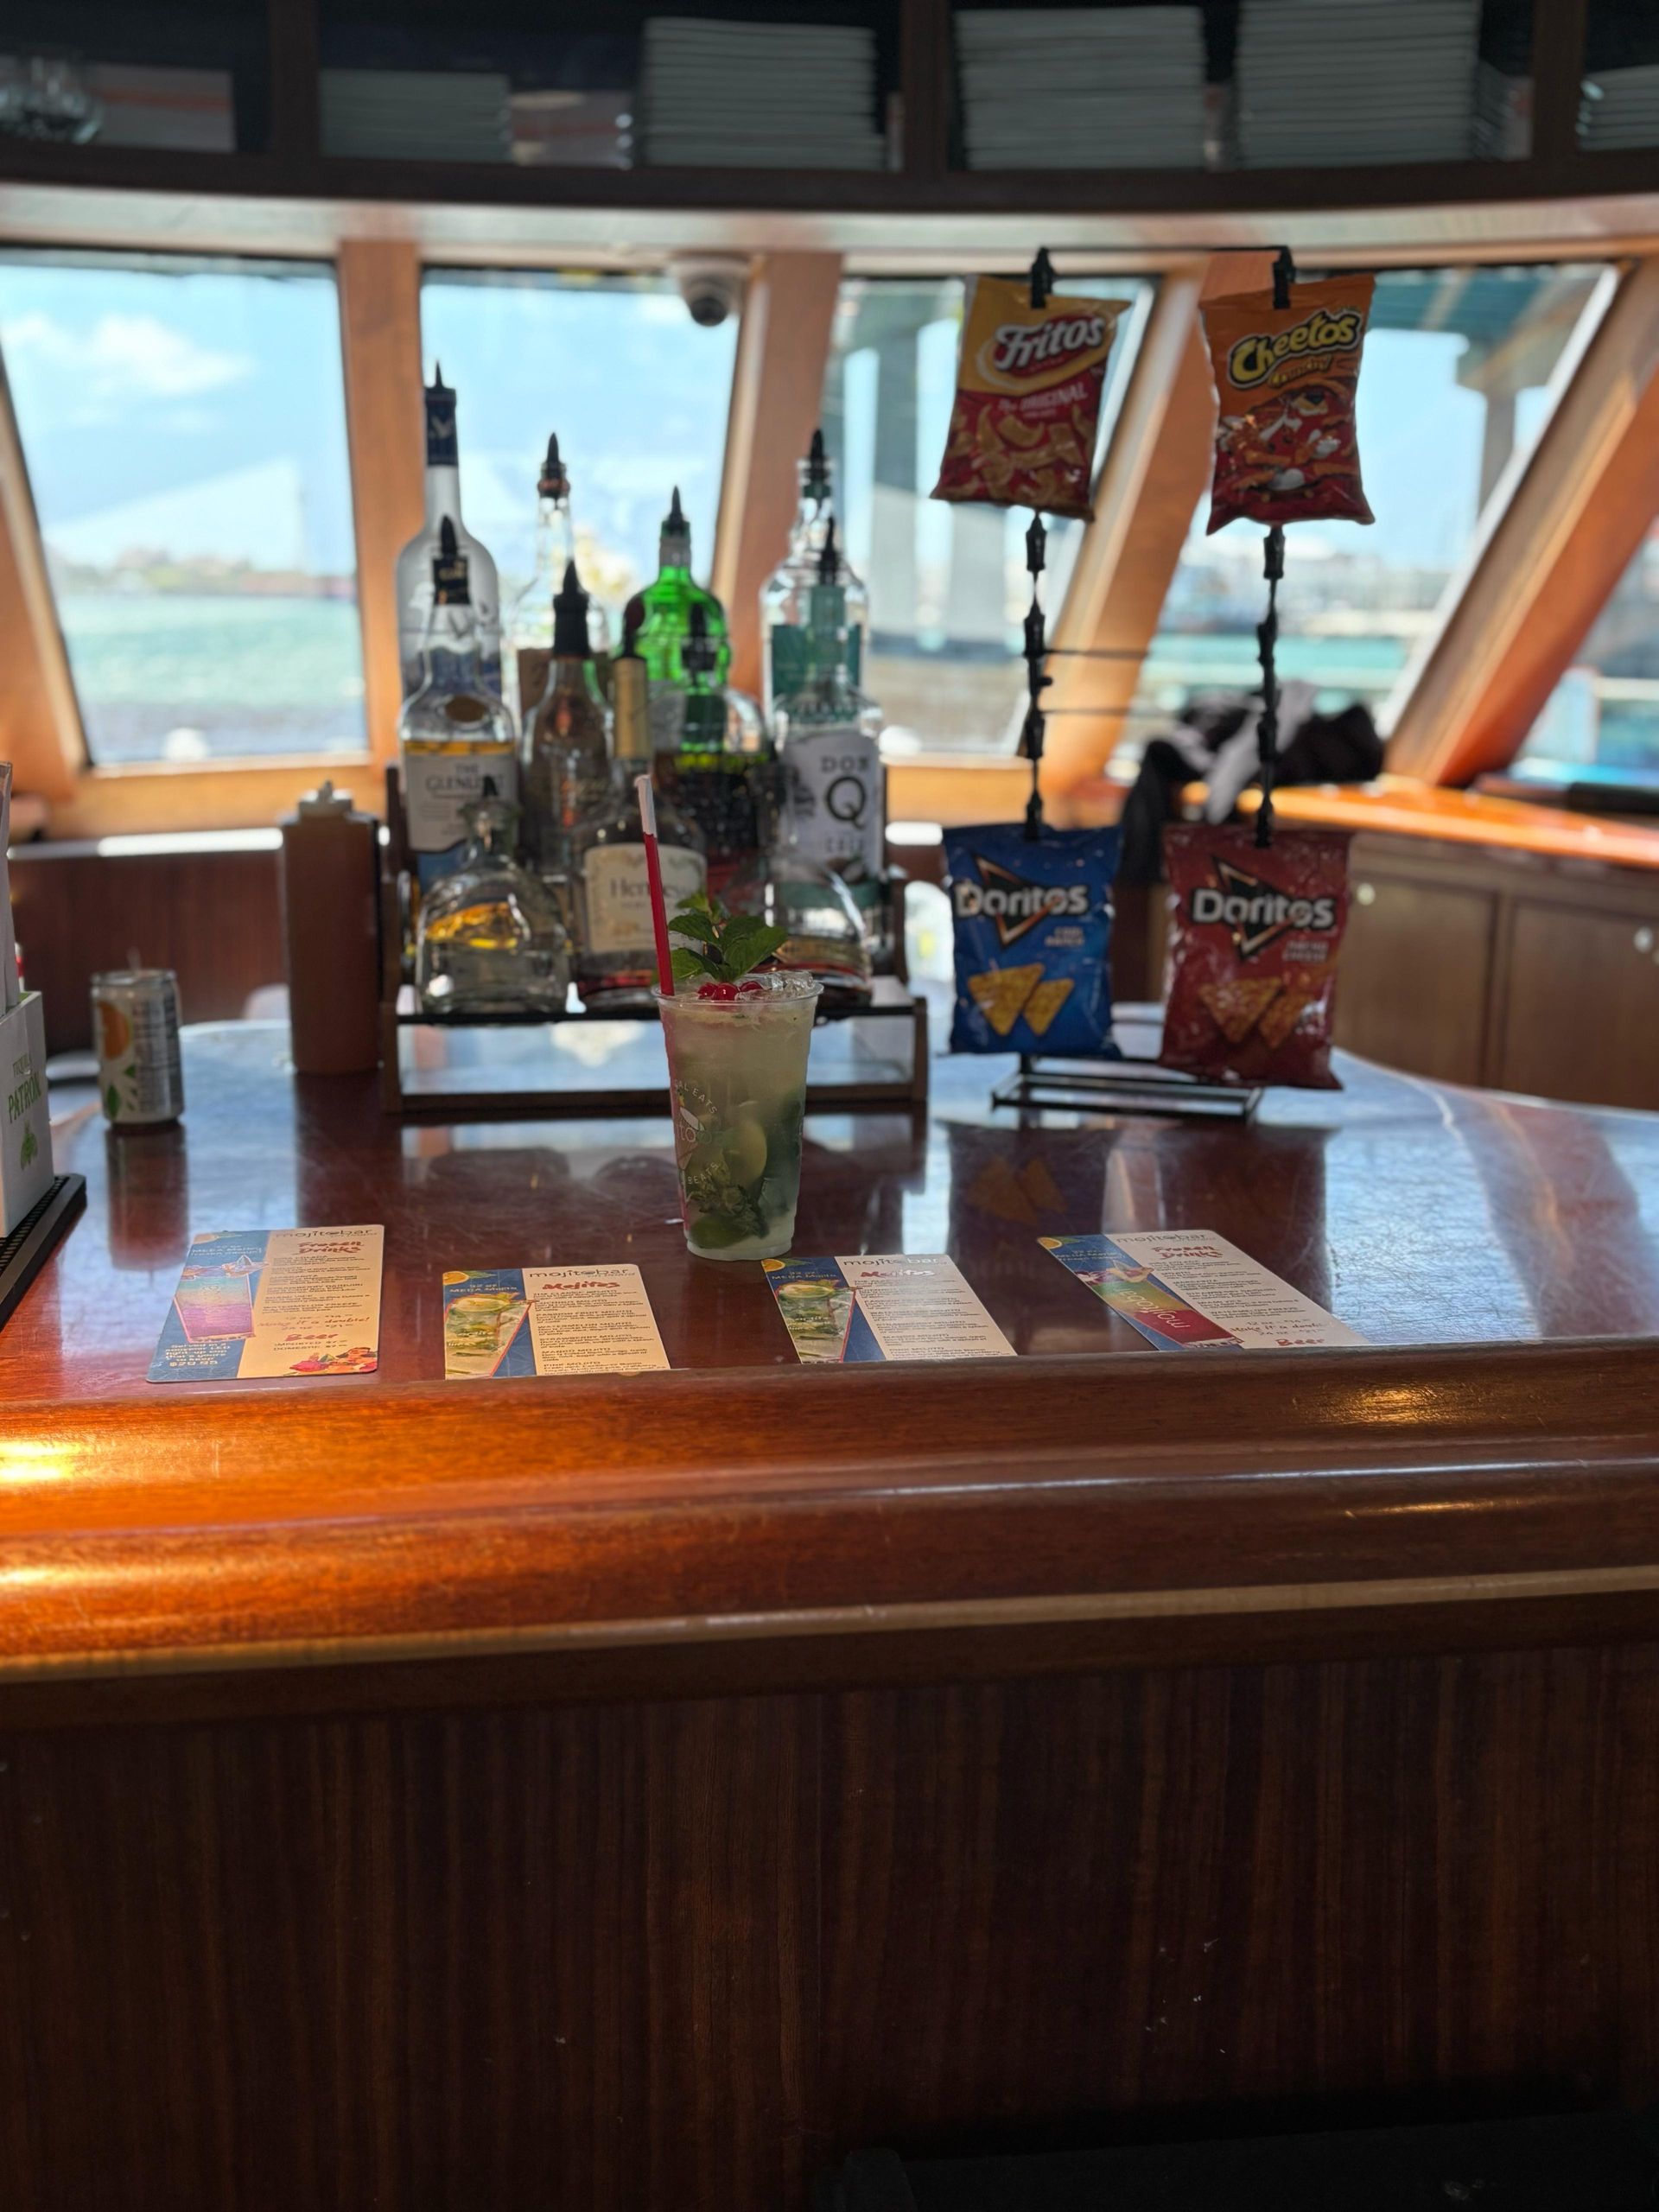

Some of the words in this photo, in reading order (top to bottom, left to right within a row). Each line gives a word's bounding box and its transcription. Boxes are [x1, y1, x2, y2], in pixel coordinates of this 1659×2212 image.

[994, 317, 1105, 371] Fritos
[1232, 312, 1357, 382] Cheetos
[826, 776, 867, 830] Q
[955, 882, 1089, 918] Doritos
[1193, 889, 1334, 928] Doritos
[692, 1088, 717, 1114] EATS
[687, 1162, 719, 1185] BEATS
[1160, 1251, 1224, 1260] Drinks
[543, 1281, 620, 1290] Mojitos
